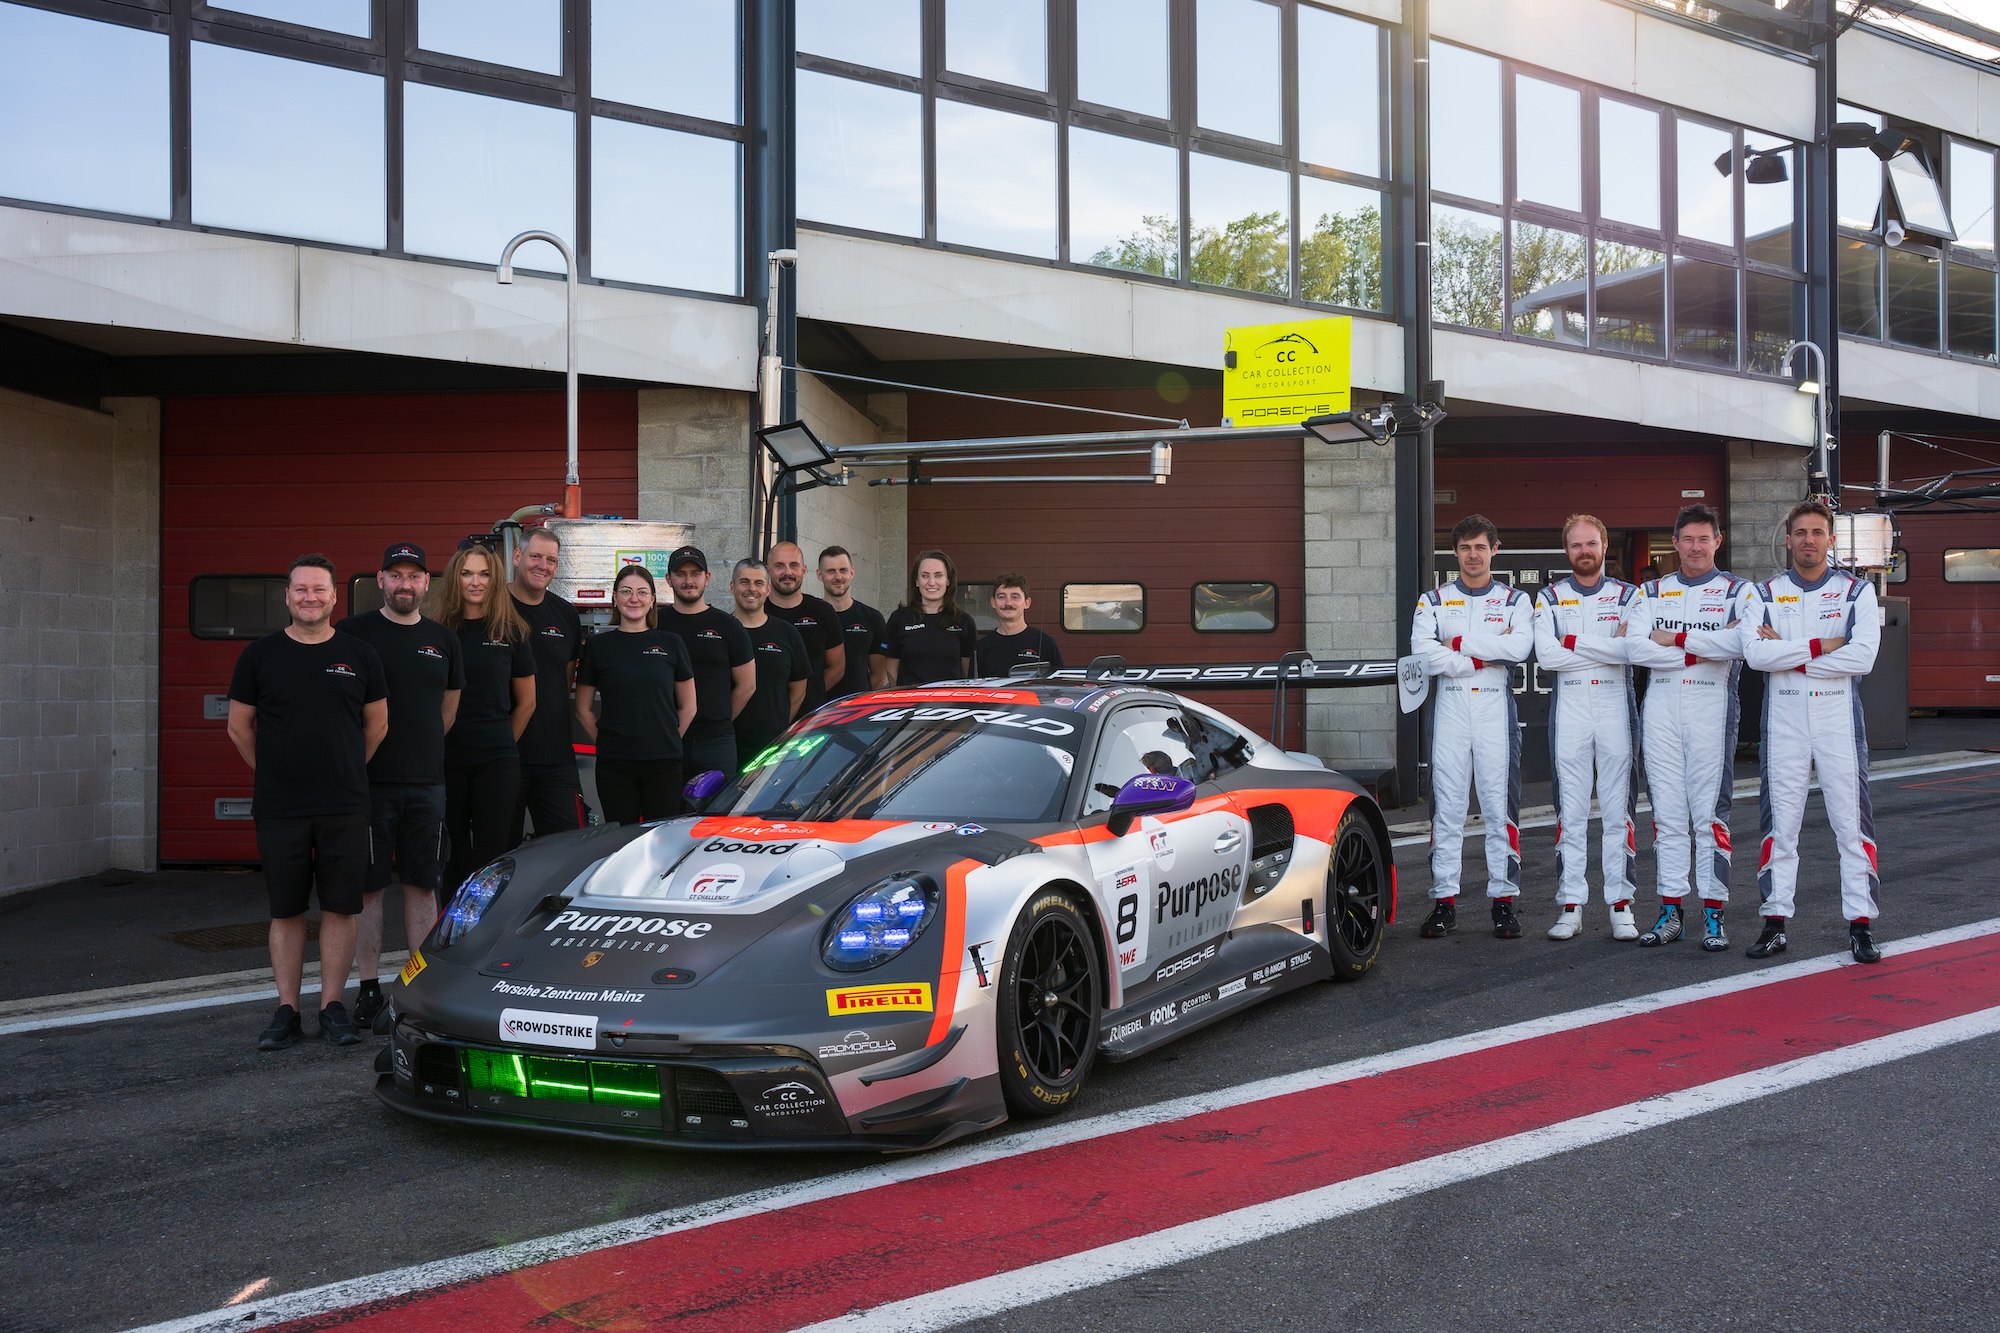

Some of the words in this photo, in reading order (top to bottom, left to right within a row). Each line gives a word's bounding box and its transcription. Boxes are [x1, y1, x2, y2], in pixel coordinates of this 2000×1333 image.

[1276, 350, 1296, 363] CC
[1242, 370, 1262, 379] CAR
[1266, 365, 1331, 377] COLLECTION
[1255, 379, 1316, 389] MOTORSPORT
[1242, 404, 1330, 417] PORSCHE
[647, 553, 670, 562] 100%
[1048, 664, 1396, 681] PORSCHE
[1405, 661, 1423, 680] aws
[871, 691, 1018, 700] PORSCHE
[868, 708, 1075, 736] WORLD
[703, 838, 800, 855] board
[1157, 864, 1242, 924] Purpose
[1032, 895, 1075, 917] PIRELLI
[544, 910, 713, 939] Purpose
[1116, 893, 1138, 945] 8
[550, 937, 670, 953] UNLIMITED
[1156, 944, 1215, 982] PORSCHE
[492, 980, 540, 998] Porsche
[539, 986, 598, 1002] Zentrum
[599, 989, 645, 1003] Mainz
[836, 988, 923, 1010] PIRELLI
[509, 1020, 593, 1038] CROWDSTRIKE
[1121, 1018, 1144, 1037] RIEDEL
[818, 1039, 897, 1054] PROMOFOLIA
[754, 1103, 771, 1111] CAR
[773, 1098, 826, 1110] COLLECTION
[780, 1092, 798, 1101] CC
[765, 1108, 816, 1117] MOTORSPORT
